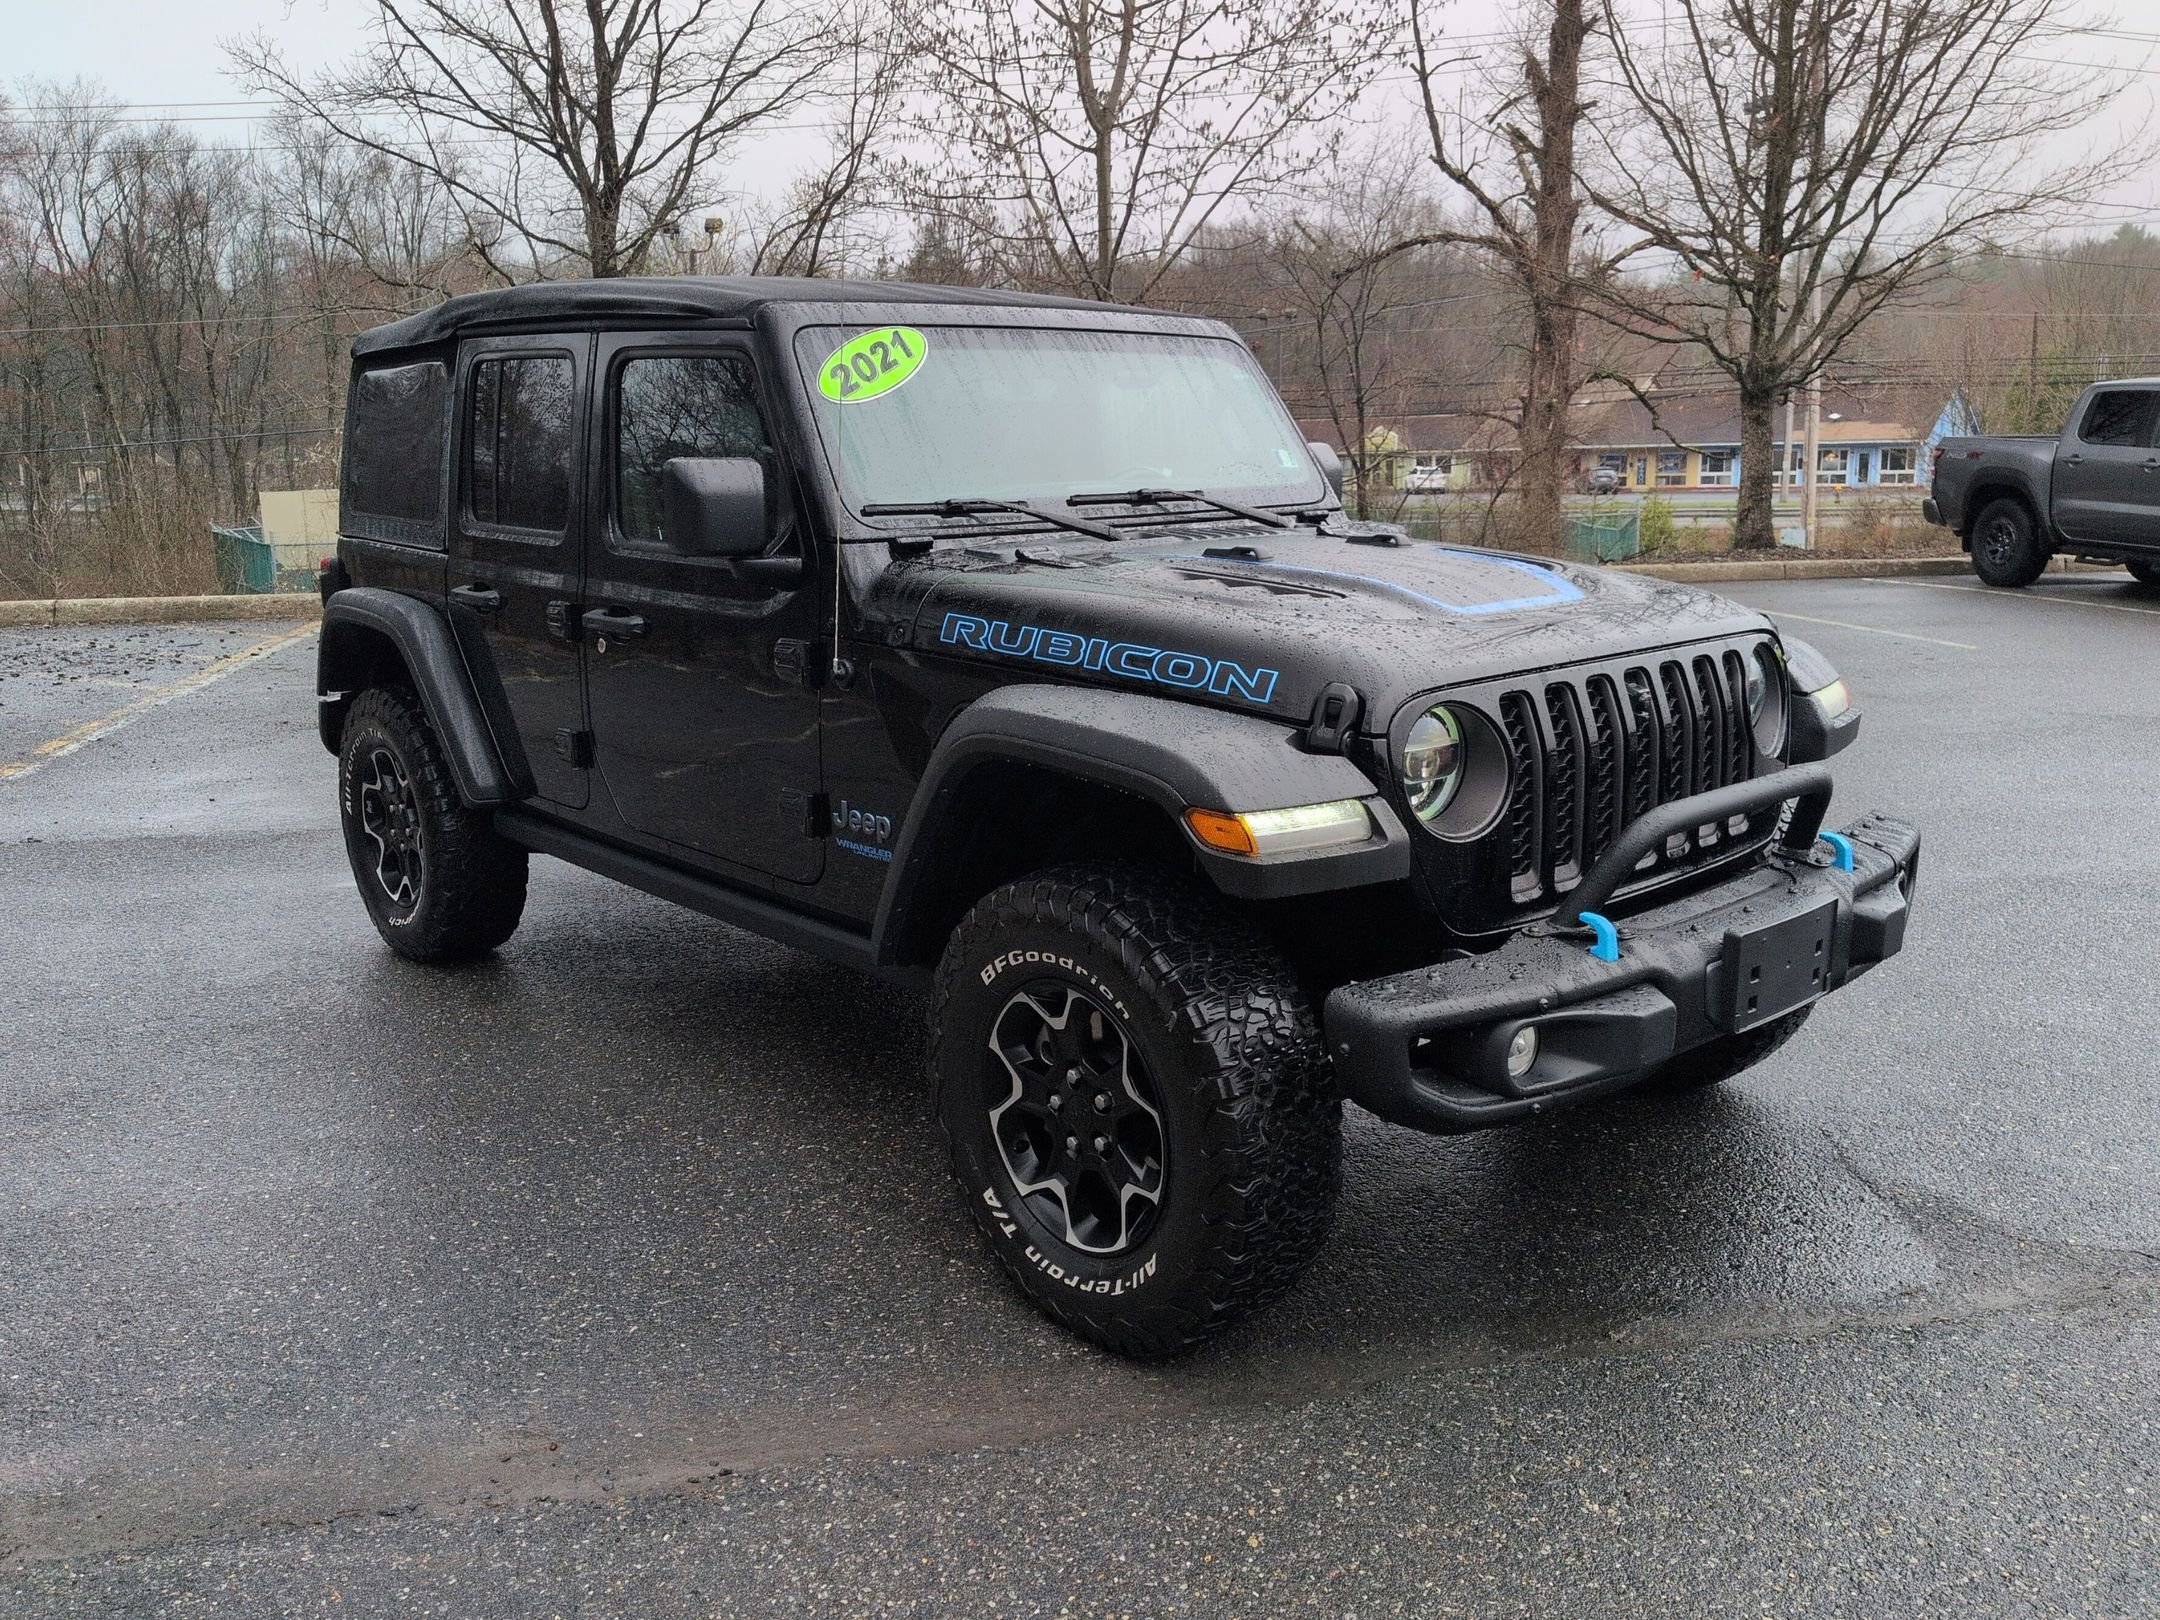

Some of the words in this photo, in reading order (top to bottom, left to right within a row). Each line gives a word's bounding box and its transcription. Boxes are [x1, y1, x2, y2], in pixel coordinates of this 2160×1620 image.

[829, 330, 913, 397] 2021
[939, 612, 1280, 704] RUBICON
[832, 800, 891, 844] Jeep
[835, 837, 893, 858] WRANGLER
[980, 950, 1130, 1020] BFGoodrich
[982, 1186, 1018, 1239] T/A
[1024, 1245, 1157, 1296] All-Terrain
